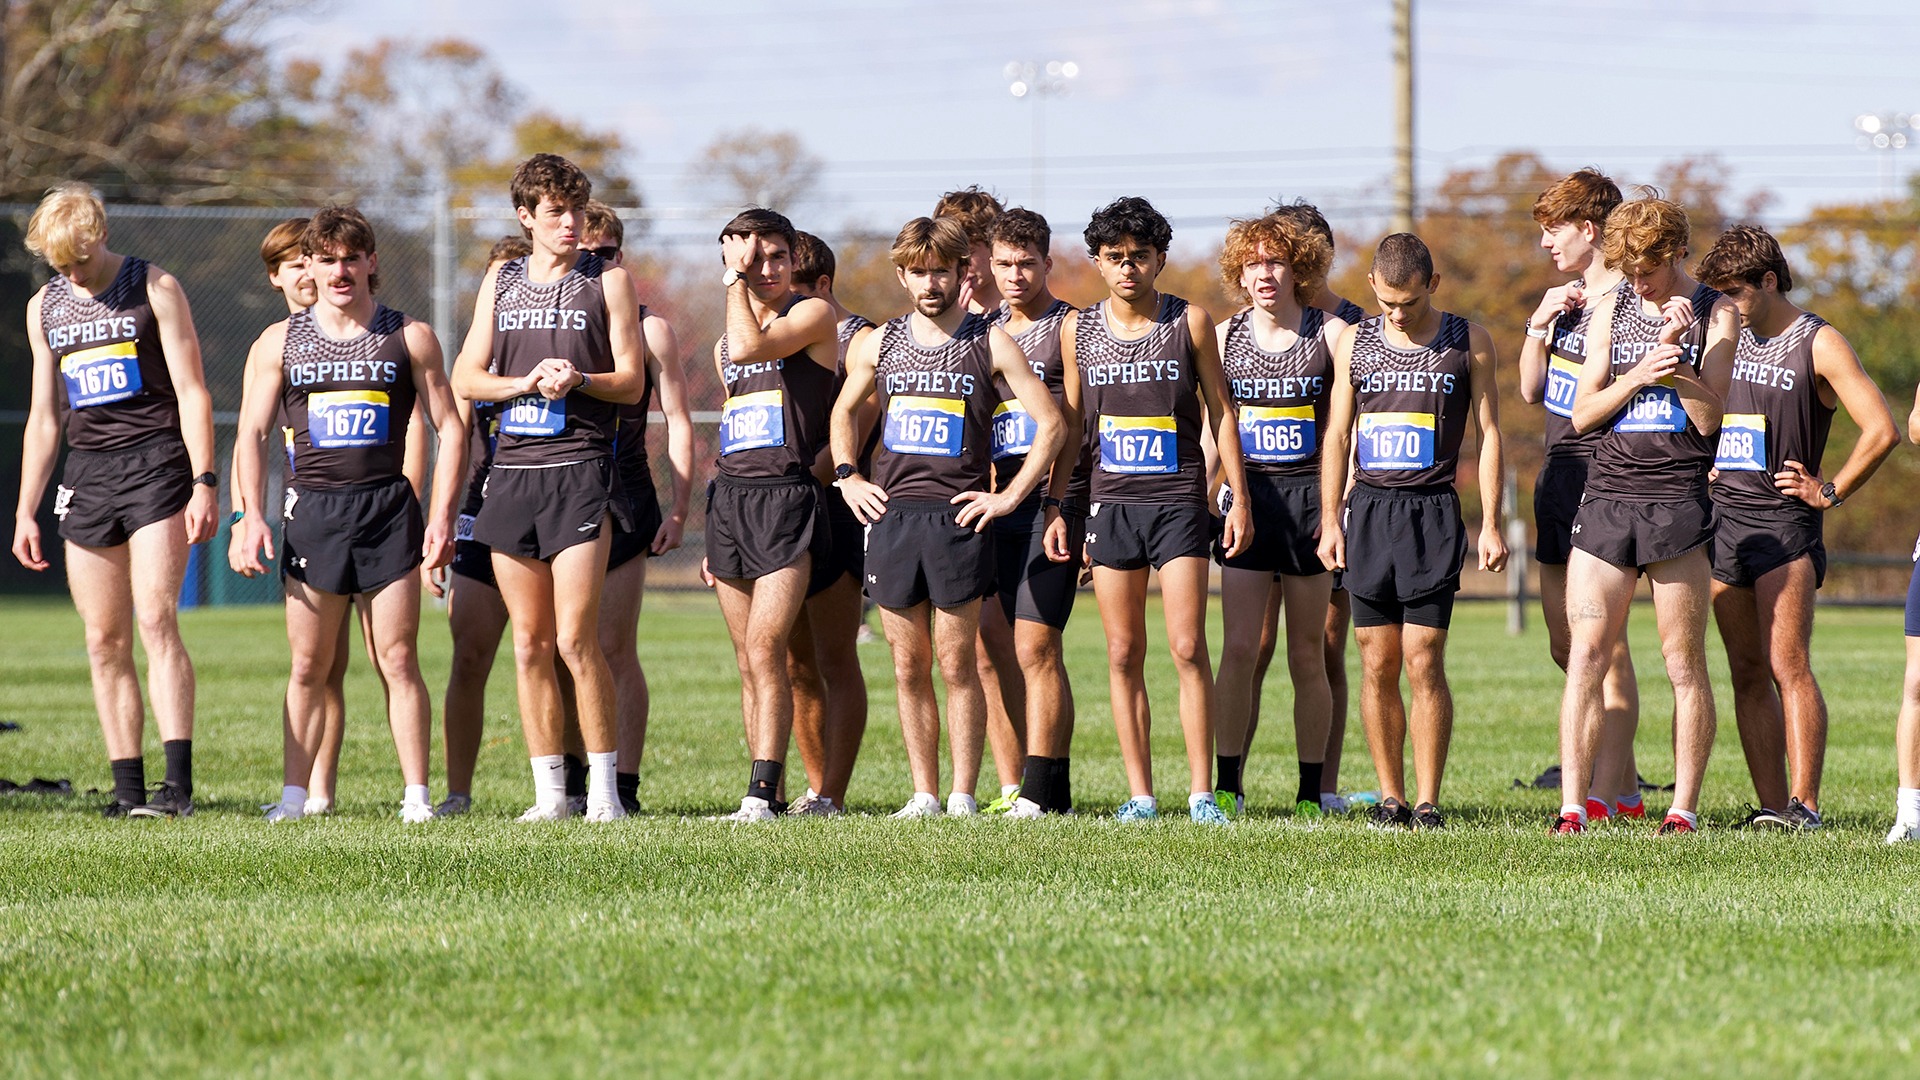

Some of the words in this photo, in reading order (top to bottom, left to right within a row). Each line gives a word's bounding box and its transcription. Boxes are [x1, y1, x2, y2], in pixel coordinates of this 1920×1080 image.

[48, 316, 137, 350] OSPREYS
[498, 309, 587, 332] OSPREYS
[77, 362, 128, 396] 1676
[290, 360, 397, 387] OSPREYS
[886, 371, 975, 396] OSPREYS
[1087, 359, 1180, 387] OSPREYS
[1360, 371, 1456, 395] OSPREYS
[1231, 376, 1324, 399] OSPREYS
[1547, 372, 1576, 405] 1677
[324, 408, 376, 436] 1672
[509, 397, 551, 424] 1667
[728, 409, 770, 441] 1682
[899, 414, 949, 444] 1675
[992, 416, 1026, 448] 1681
[1251, 424, 1303, 451] 1665
[1112, 435, 1164, 462] 1674
[1370, 430, 1420, 458] 1670
